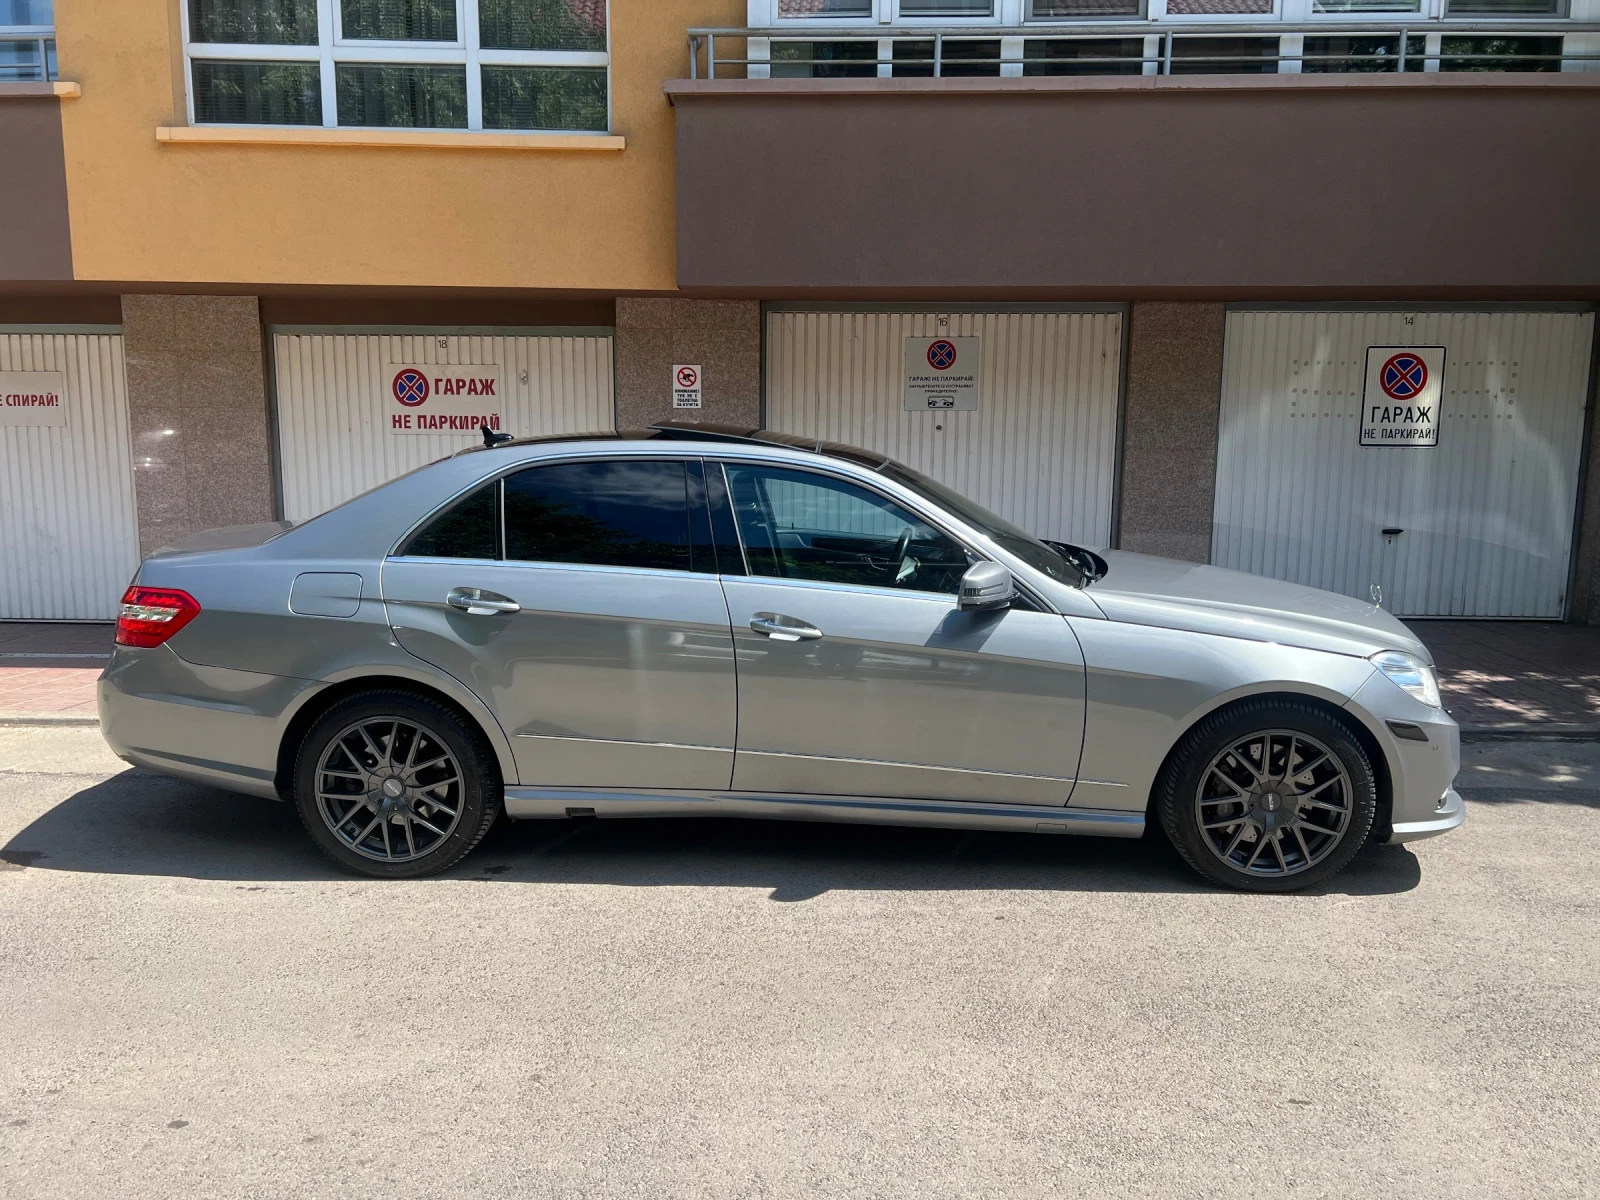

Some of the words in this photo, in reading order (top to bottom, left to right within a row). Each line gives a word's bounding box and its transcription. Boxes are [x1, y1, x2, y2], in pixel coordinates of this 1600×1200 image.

[937, 317, 948, 327] 16
[1404, 316, 1414, 326] 14
[438, 339, 448, 349] 18
[434, 378, 496, 396] ГАРАЖ
[5, 392, 59, 407] СПИРАЙ!
[1371, 406, 1432, 423] ГАРАЖ
[392, 414, 412, 429] НЕ
[417, 413, 500, 431] ПАРКИРАЙ
[1364, 428, 1376, 439] НЕ
[1381, 427, 1435, 439] ПАРКИРАЙ!
